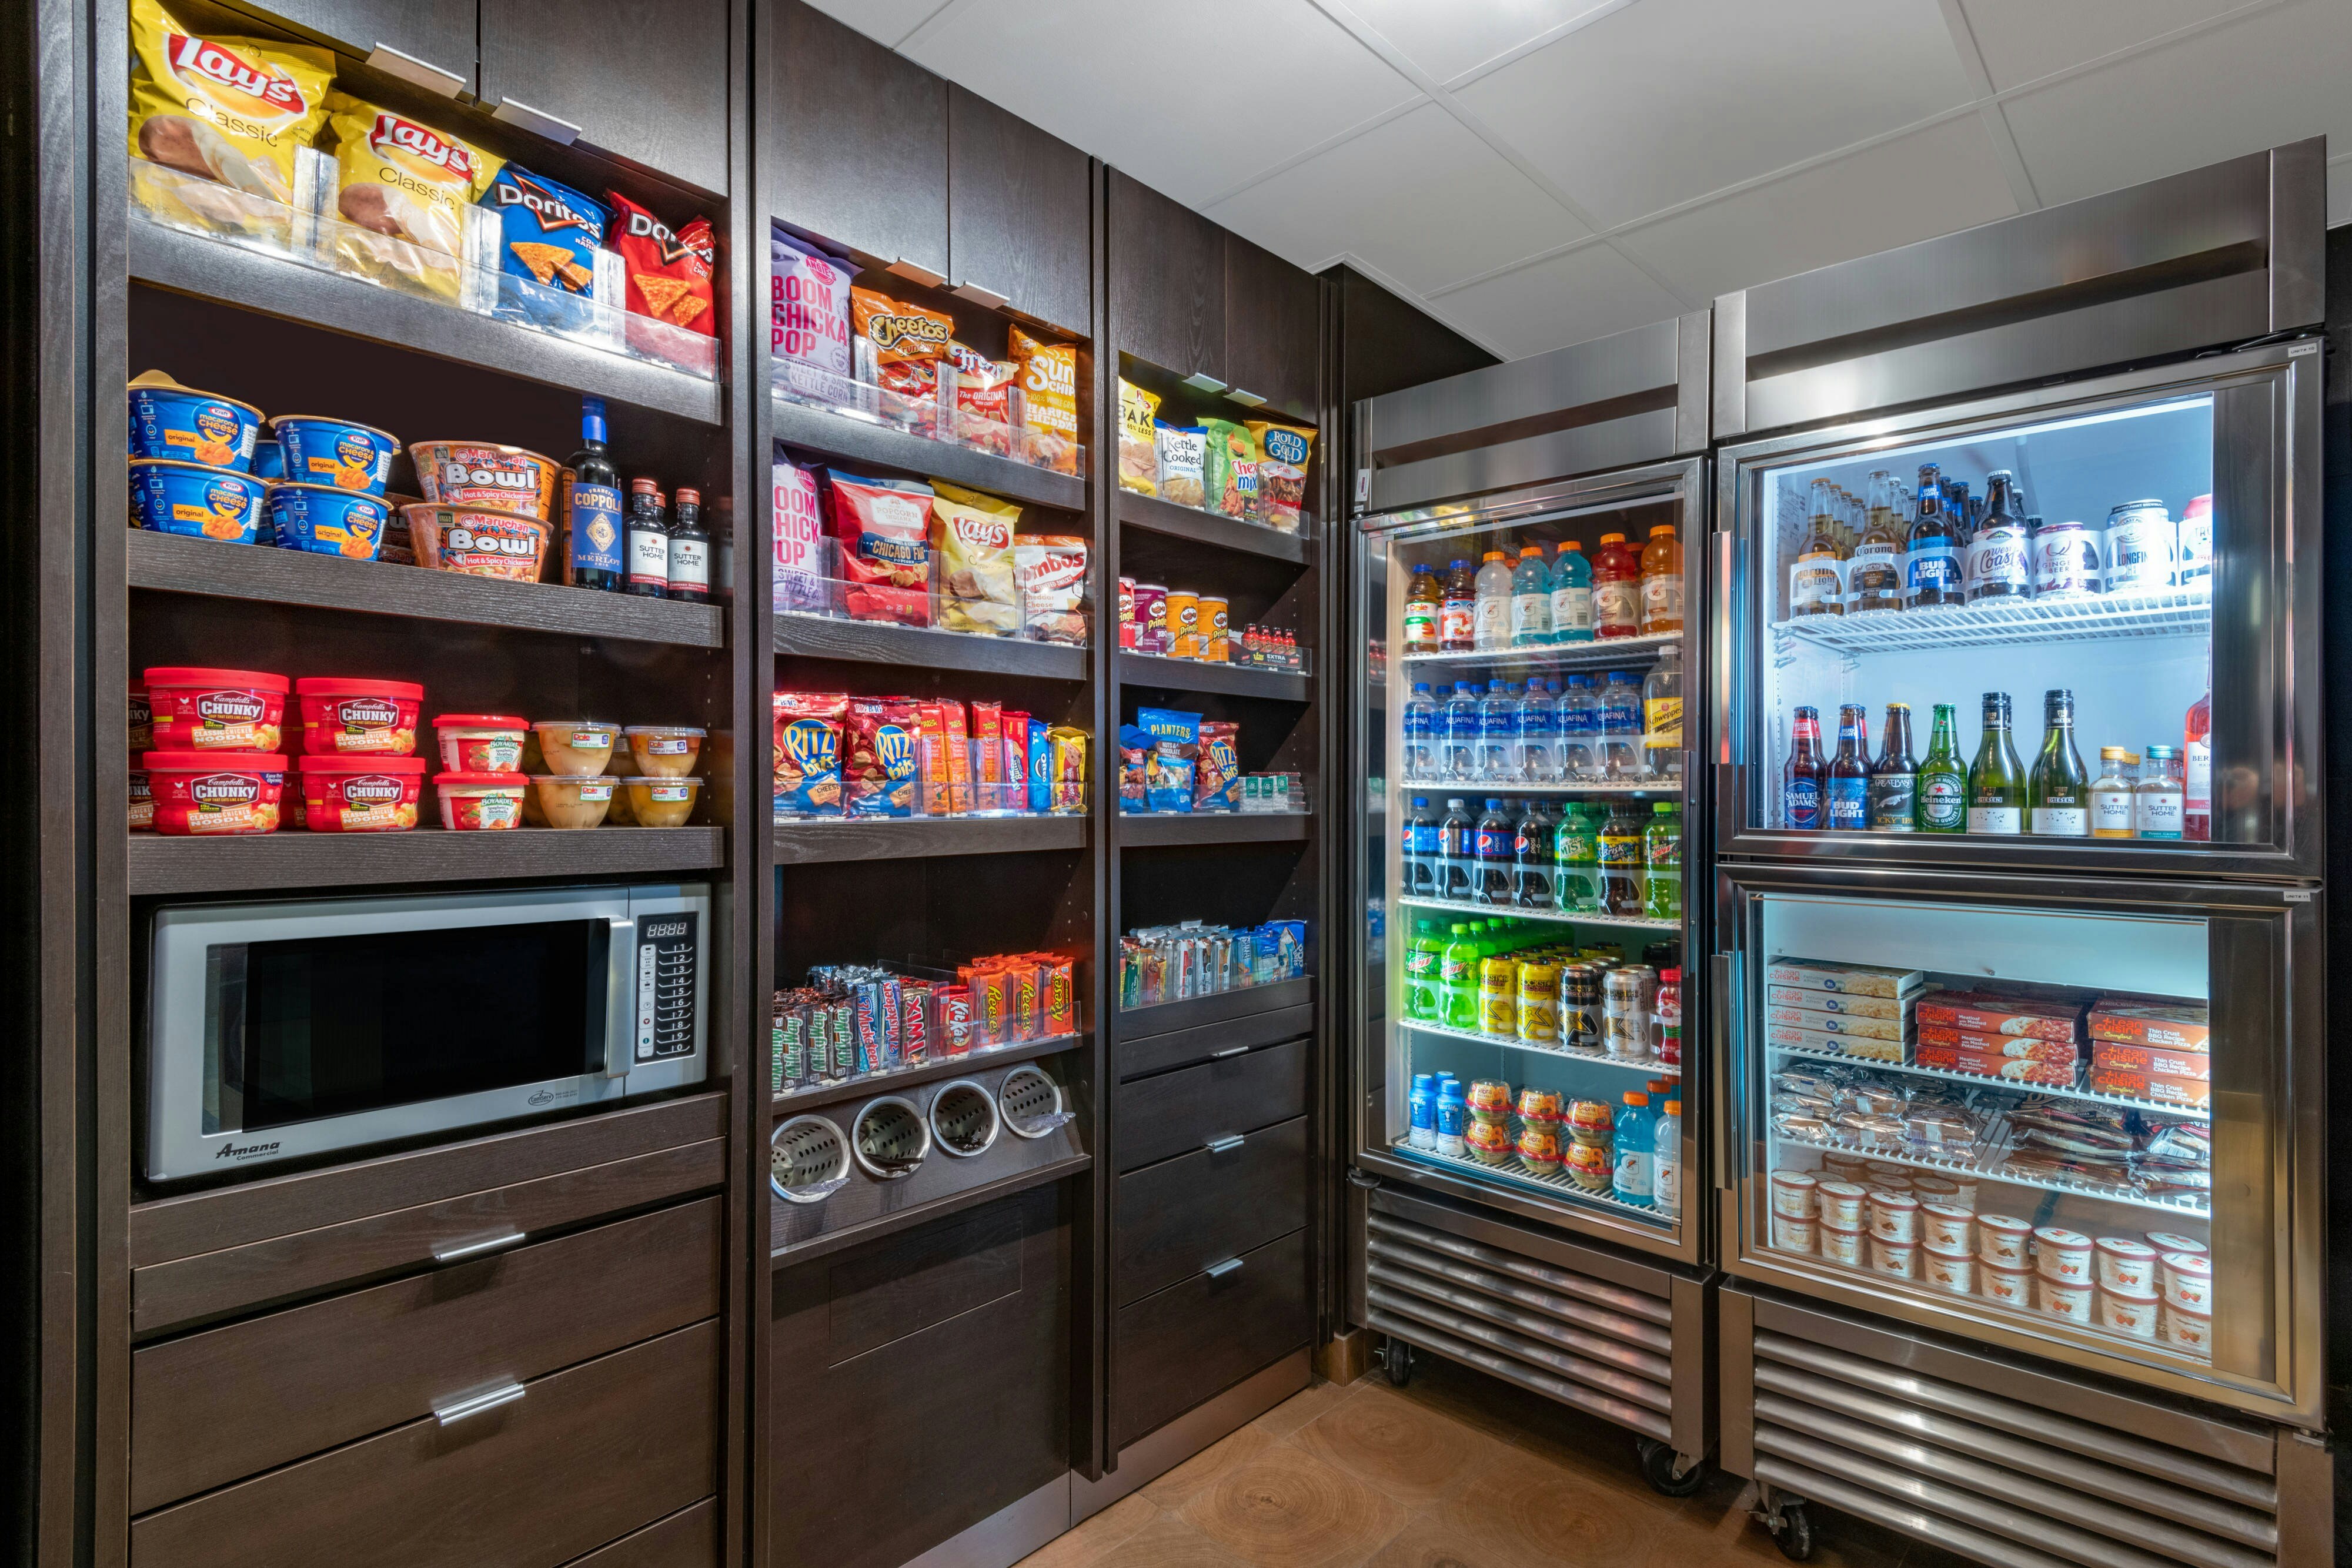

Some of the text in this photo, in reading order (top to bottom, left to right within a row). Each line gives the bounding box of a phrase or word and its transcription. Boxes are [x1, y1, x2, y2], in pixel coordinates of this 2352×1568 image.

[177, 36, 295, 105] Lay's
[186, 98, 278, 148] Classic
[376, 115, 470, 173] Lay's
[379, 167, 455, 210] Classic
[498, 183, 601, 240] Doritos
[771, 275, 833, 312] BOOM
[771, 303, 847, 347] CHICKA
[871, 313, 948, 347] Cheetos
[771, 328, 817, 358] POP
[1026, 355, 1075, 391] Sun
[959, 390, 1006, 402] The ORIGINAL
[199, 414, 235, 426] macaroni
[1138, 426, 1152, 436] LESS
[168, 434, 195, 443] original
[1168, 437, 1198, 452] Kettle
[1274, 430, 1302, 448] ROLD
[339, 442, 370, 452] macaroni
[1269, 442, 1302, 462] GOLD
[1163, 450, 1201, 465] Cooked
[311, 460, 335, 469] original
[1232, 460, 1258, 476] Chex
[445, 463, 536, 489] Bowl
[1238, 475, 1258, 492] mix
[210, 489, 244, 500] macaroni
[482, 491, 500, 500] Spicy
[574, 492, 621, 513] COPPOLA
[176, 508, 203, 517] original
[348, 511, 375, 524] macaroni
[474, 514, 529, 534] Maruchan
[317, 529, 342, 538] original
[448, 528, 536, 556] Bowl
[639, 545, 665, 554] SUTTER
[873, 540, 911, 559] CHICAGO
[1856, 546, 1892, 556] Corona
[486, 558, 504, 566] Spicy
[577, 554, 620, 566] MERLOT
[643, 552, 664, 560] HOME
[1919, 560, 1947, 570] BUD
[1915, 569, 1951, 579] LIGHT
[1813, 576, 1835, 586] Light
[201, 701, 260, 718] CHUNKY
[854, 704, 883, 713] BIG BAG
[342, 708, 396, 723] CHUNKY
[1446, 716, 1475, 725] AQUAFINA
[1517, 714, 1547, 724] AQUAFINA
[1558, 714, 1589, 724] AQUAFINA
[1649, 705, 1683, 725] Schweppes
[1479, 717, 1508, 726] AQUAFINA
[1150, 724, 1191, 739] PLANTERS
[195, 733, 253, 743] NOODLE
[338, 738, 392, 747] NOODLE
[786, 727, 833, 762] RITZ
[877, 733, 910, 765] RITZ
[1214, 745, 1236, 770] RITZ
[801, 755, 835, 778] bits
[887, 761, 915, 781] bits
[1222, 765, 1239, 781] bits
[196, 785, 256, 800] CHUNKY
[346, 785, 399, 798] CHUNKY
[816, 785, 840, 794] CHEESE
[1786, 791, 1820, 801] SAMUEL
[1920, 795, 1962, 804] Heineken
[1787, 800, 1818, 808] ADAMS
[1833, 801, 1859, 810] BUD
[190, 813, 222, 821] CLASSIC
[343, 814, 395, 824] NOODLE
[1830, 809, 1863, 818] LIGHT
[191, 815, 251, 826] NOODLE
[1561, 840, 1584, 855] MIST
[1050, 974, 1063, 1022] Reese's
[988, 985, 1003, 1035] Reese's
[1021, 982, 1036, 1031] Reese's
[1933, 1008, 1956, 1017] Lean
[883, 982, 899, 1045] Musketeers
[2114, 1019, 2143, 1029] Lean
[858, 998, 879, 1070] 3 Musketeers
[1935, 1028, 1958, 1037] Lean
[2104, 1031, 2133, 1041] Comfort
[2164, 1035, 2186, 1043] Recipe
[2118, 1048, 2147, 1057] Lean
[2109, 1060, 2138, 1070] Comfort
[2153, 1066, 2179, 1075] Chicken
[2169, 1064, 2191, 1072] Recipe
[215, 1141, 280, 1159] Amana
[236, 1149, 279, 1161] Commercial
